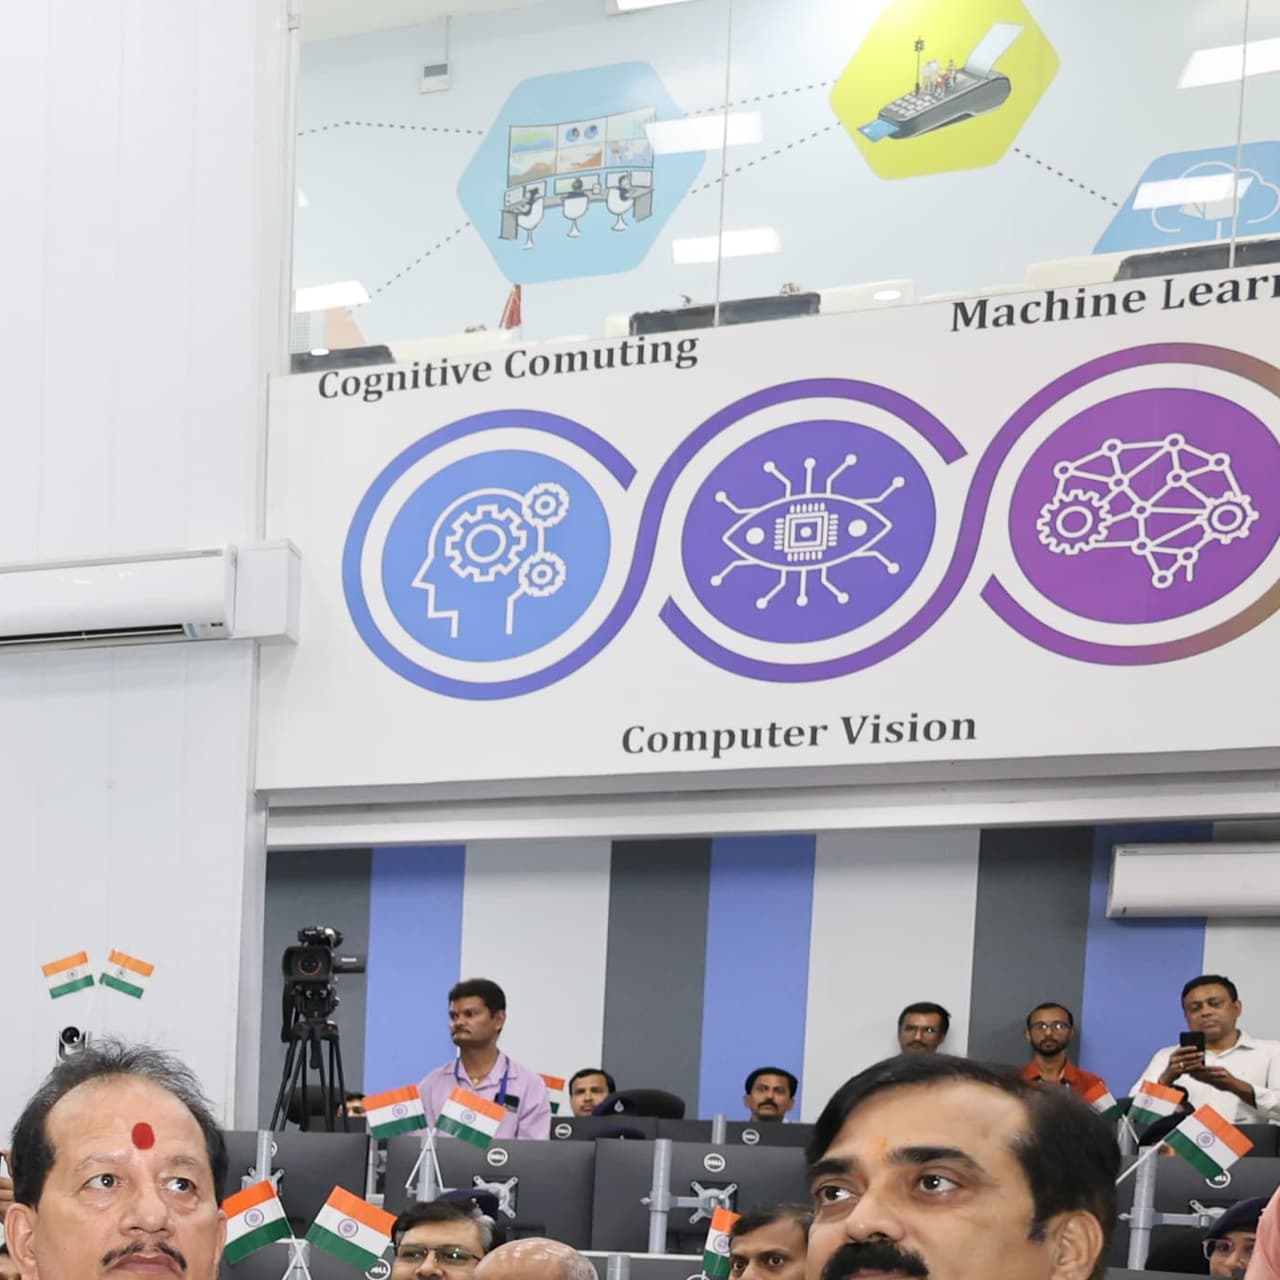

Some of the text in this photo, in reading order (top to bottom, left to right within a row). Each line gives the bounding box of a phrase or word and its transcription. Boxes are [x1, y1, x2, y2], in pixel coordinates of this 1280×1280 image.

[950, 287, 1146, 333] Machine
[318, 336, 700, 402] Cognitive Comuting
[620, 712, 978, 761] Computer Vision
